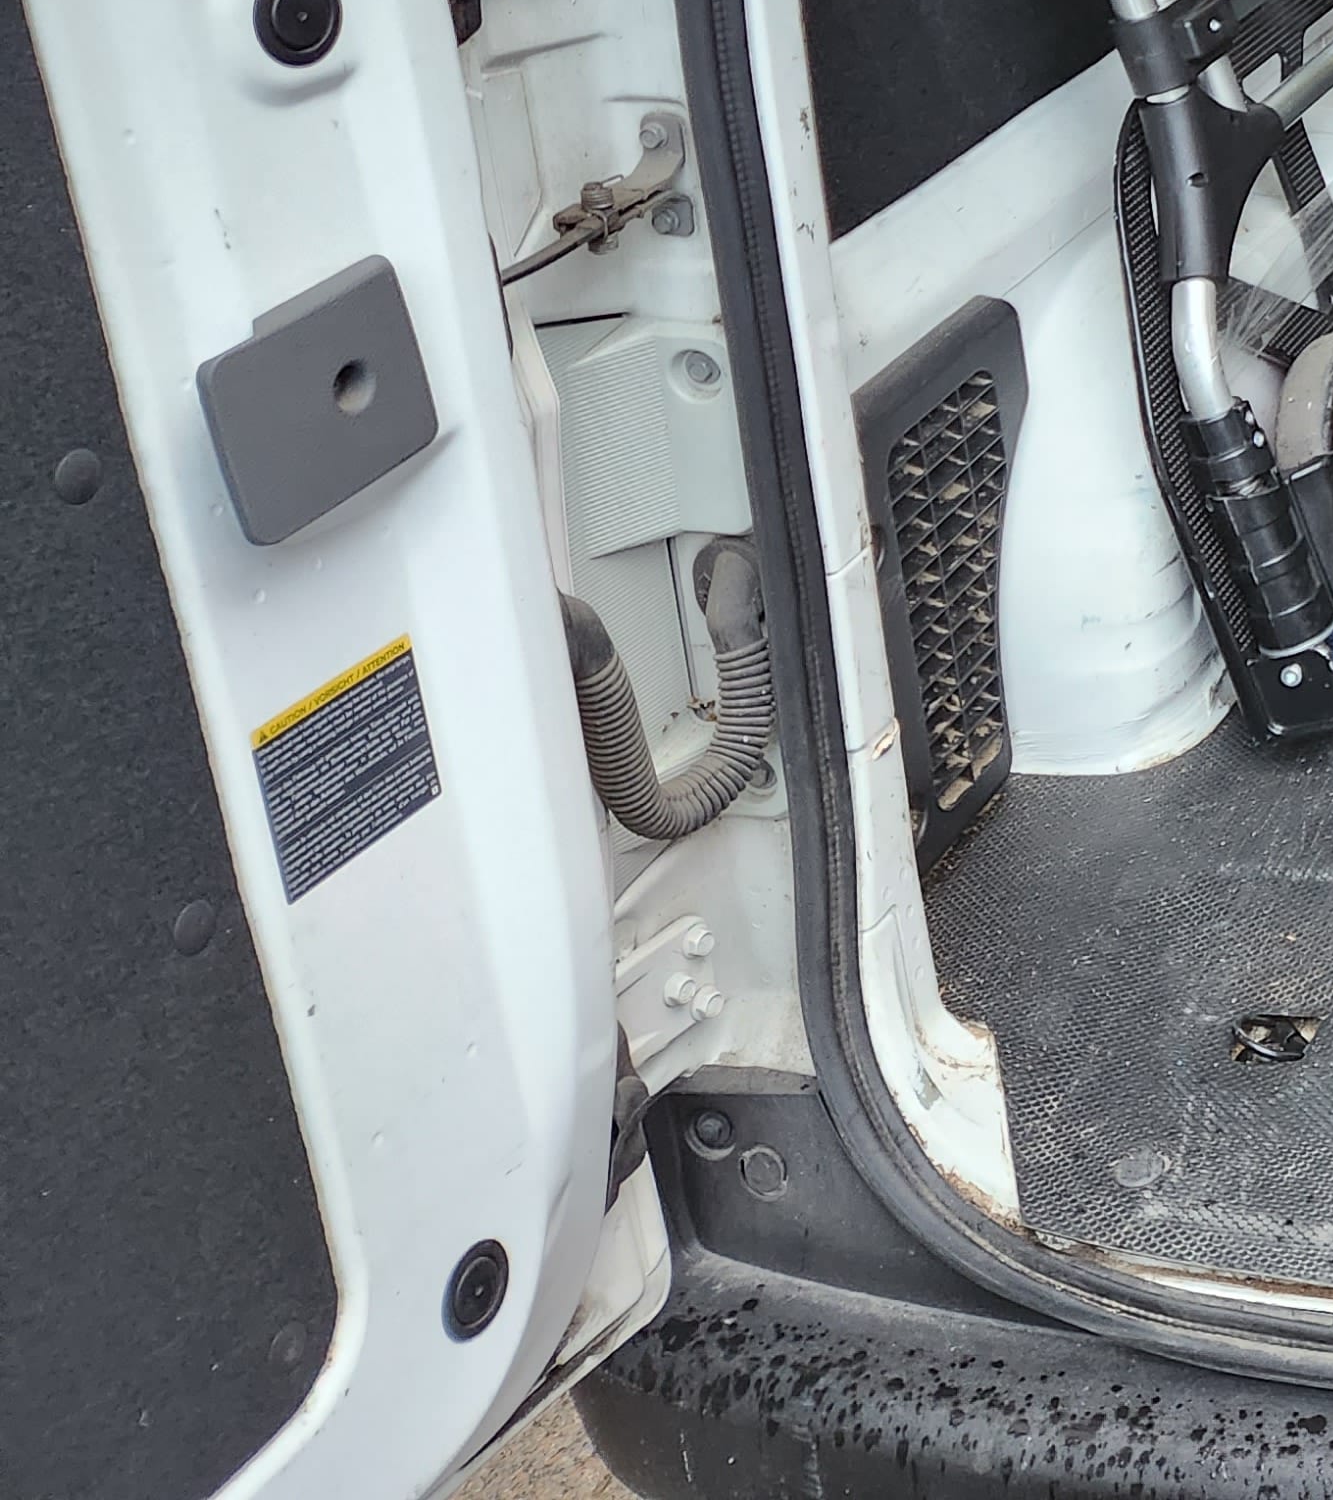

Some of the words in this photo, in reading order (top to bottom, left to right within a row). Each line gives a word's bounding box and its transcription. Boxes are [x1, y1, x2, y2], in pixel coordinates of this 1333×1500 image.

[269, 705, 306, 734] CAUTION
[314, 674, 354, 705] VORSICHT
[362, 642, 405, 674] ATTENTION
